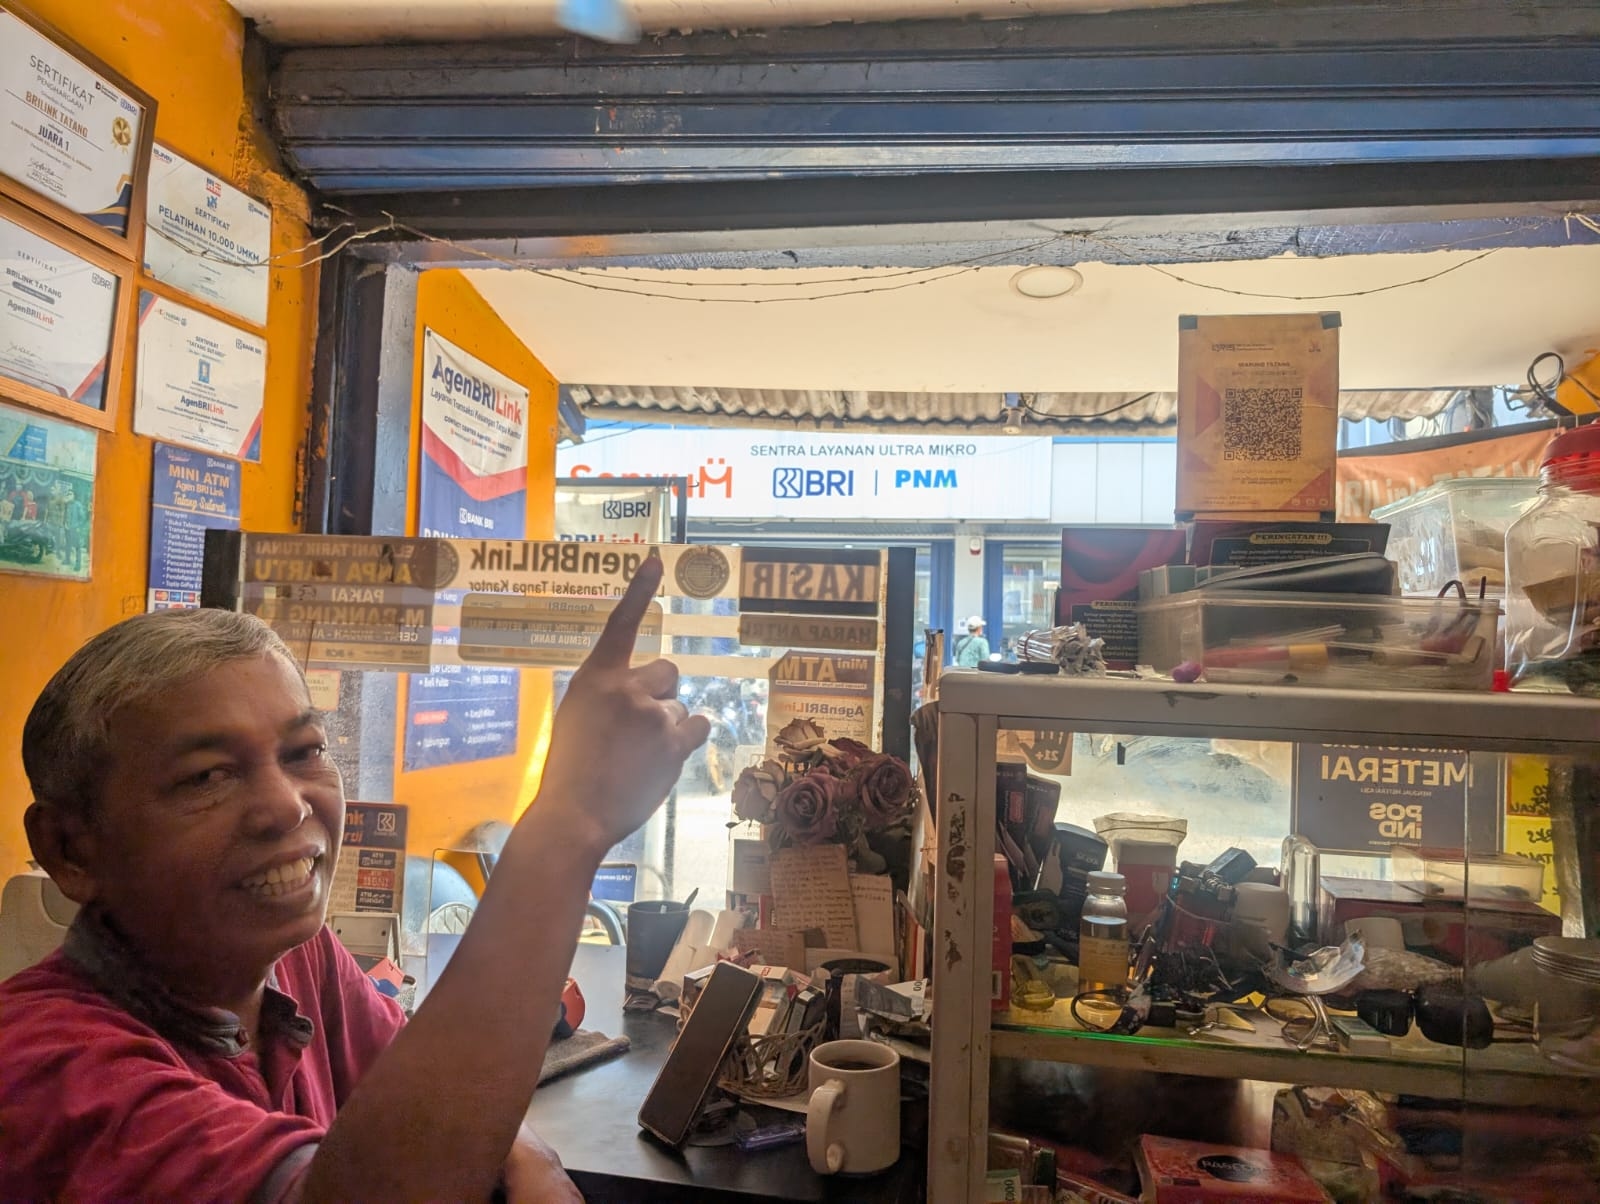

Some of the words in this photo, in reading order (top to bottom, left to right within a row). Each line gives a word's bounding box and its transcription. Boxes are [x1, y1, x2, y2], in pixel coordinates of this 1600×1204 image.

[29, 55, 95, 105] SERTIFIKAT
[37, 75, 84, 111] PENGHARGAAN
[26, 91, 58, 119] BRILINK
[60, 111, 88, 138] TATANG
[38, 124, 63, 148] JUARA
[65, 141, 70, 152] 1
[195, 207, 230, 231] SERTIFIKAT
[159, 204, 206, 236] PELATIHAN
[208, 230, 235, 250] 10.000
[236, 244, 260, 263] UMKM
[6, 267, 34, 285] BRILINK
[35, 281, 62, 298] TATANG
[8, 299, 54, 326] AgenBRILink
[431, 354, 522, 426] AgenBRILink
[180, 395, 224, 415] AgenBRILink
[453, 398, 475, 416] Transaksi
[750, 445, 806, 456] SENTRA
[810, 445, 875, 456] LAYANAN
[879, 444, 925, 456] ULTRA
[929, 443, 977, 456] MIKRO
[168, 463, 200, 482] MINI
[203, 471, 230, 489] ATM
[175, 479, 195, 493] Agen
[196, 483, 209, 495] BRI
[805, 469, 854, 497] BRI
[895, 469, 958, 488] PNM
[466, 512, 484, 528] BANK
[484, 518, 494, 530] BRI
[623, 501, 651, 518] BRI
